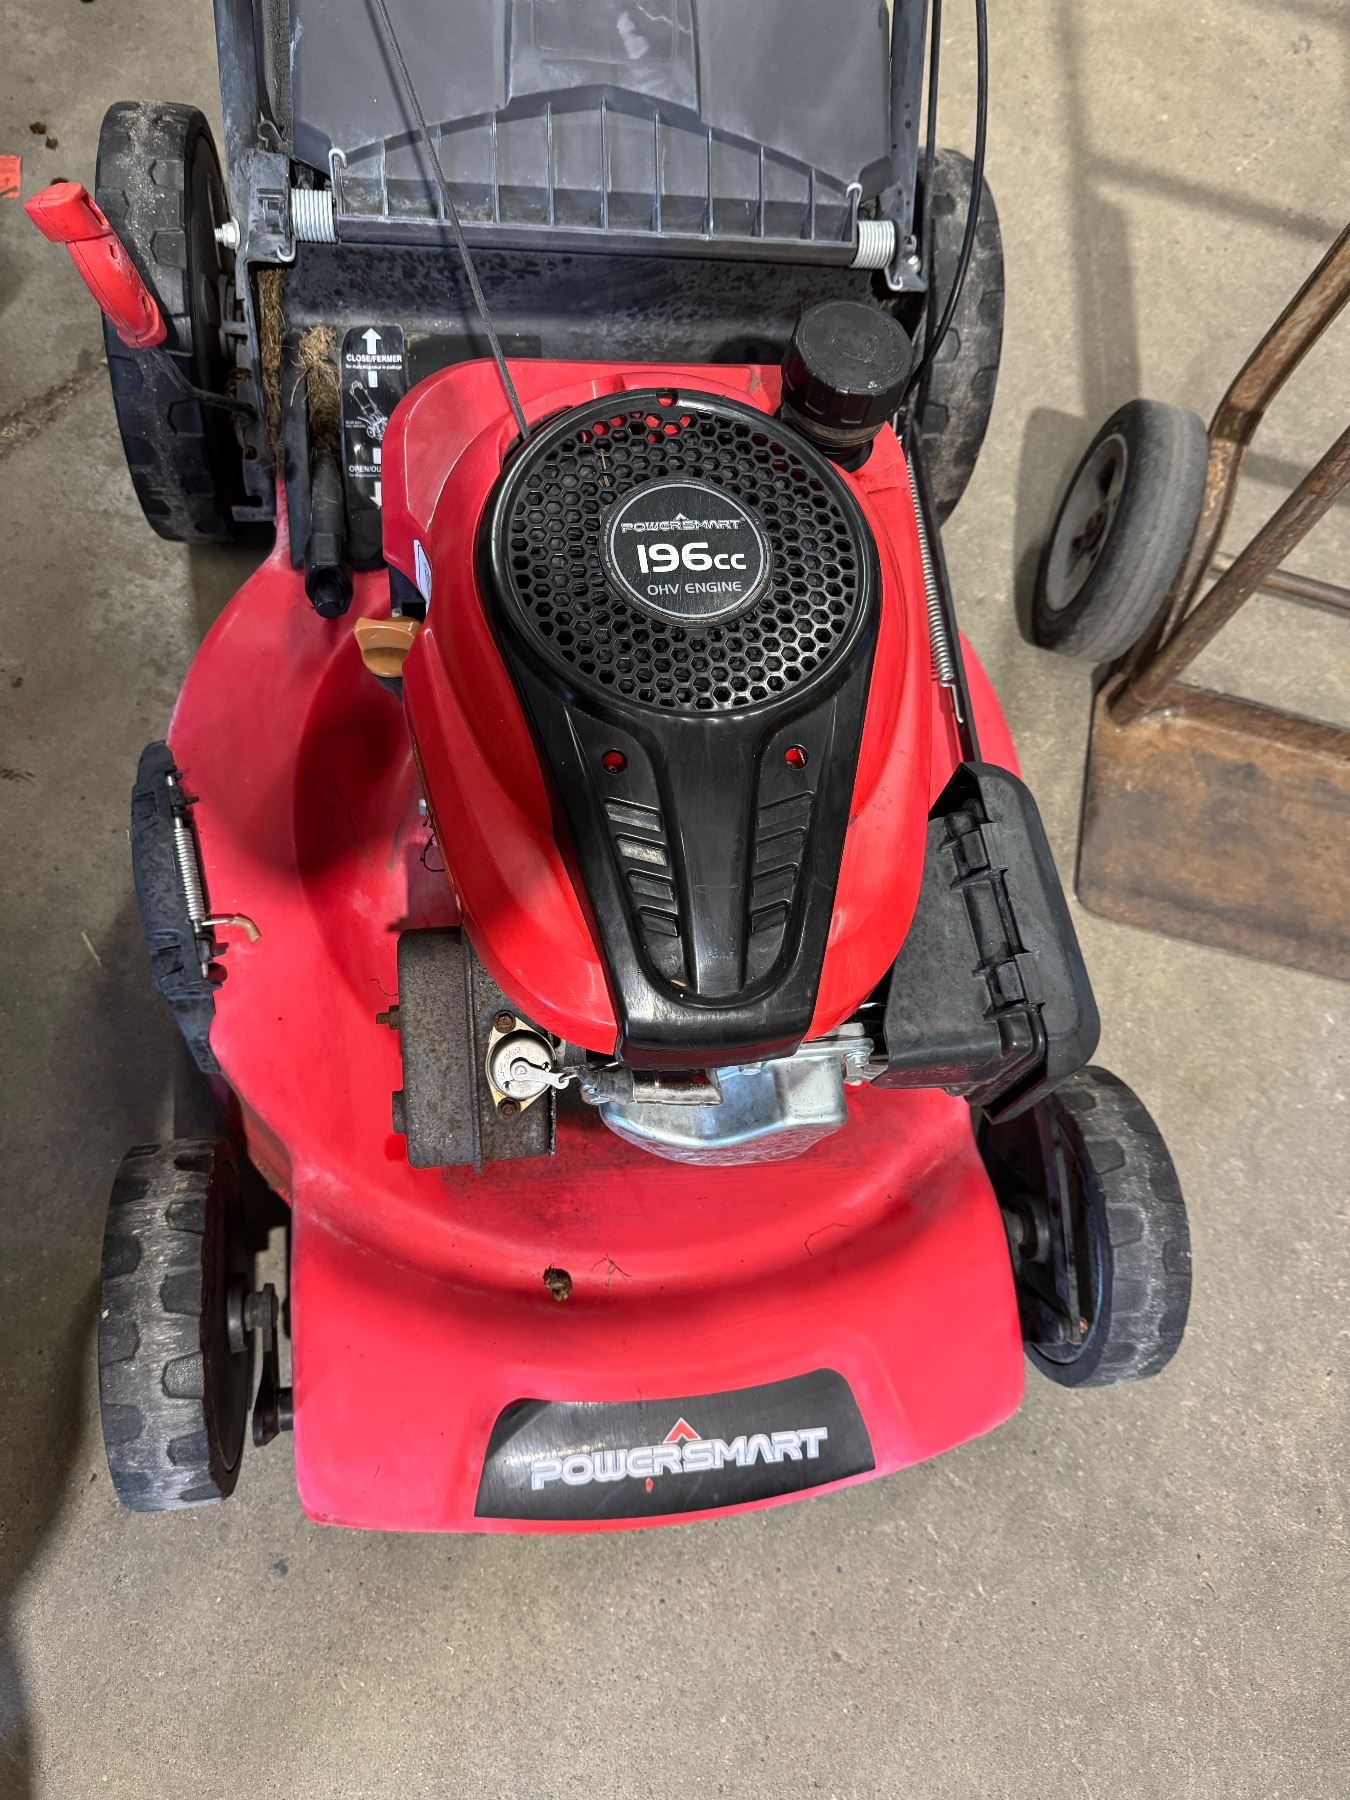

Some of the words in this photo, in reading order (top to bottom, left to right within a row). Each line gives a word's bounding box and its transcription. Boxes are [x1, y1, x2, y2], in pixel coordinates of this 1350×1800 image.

[346, 353, 402, 363] CLOSE/FERMER
[620, 518, 741, 533] POWERSMART
[636, 542, 747, 574] 196cc
[647, 583, 679, 596] OHV
[684, 581, 742, 594] ENGINE
[531, 1426, 829, 1491] POWERSMART
